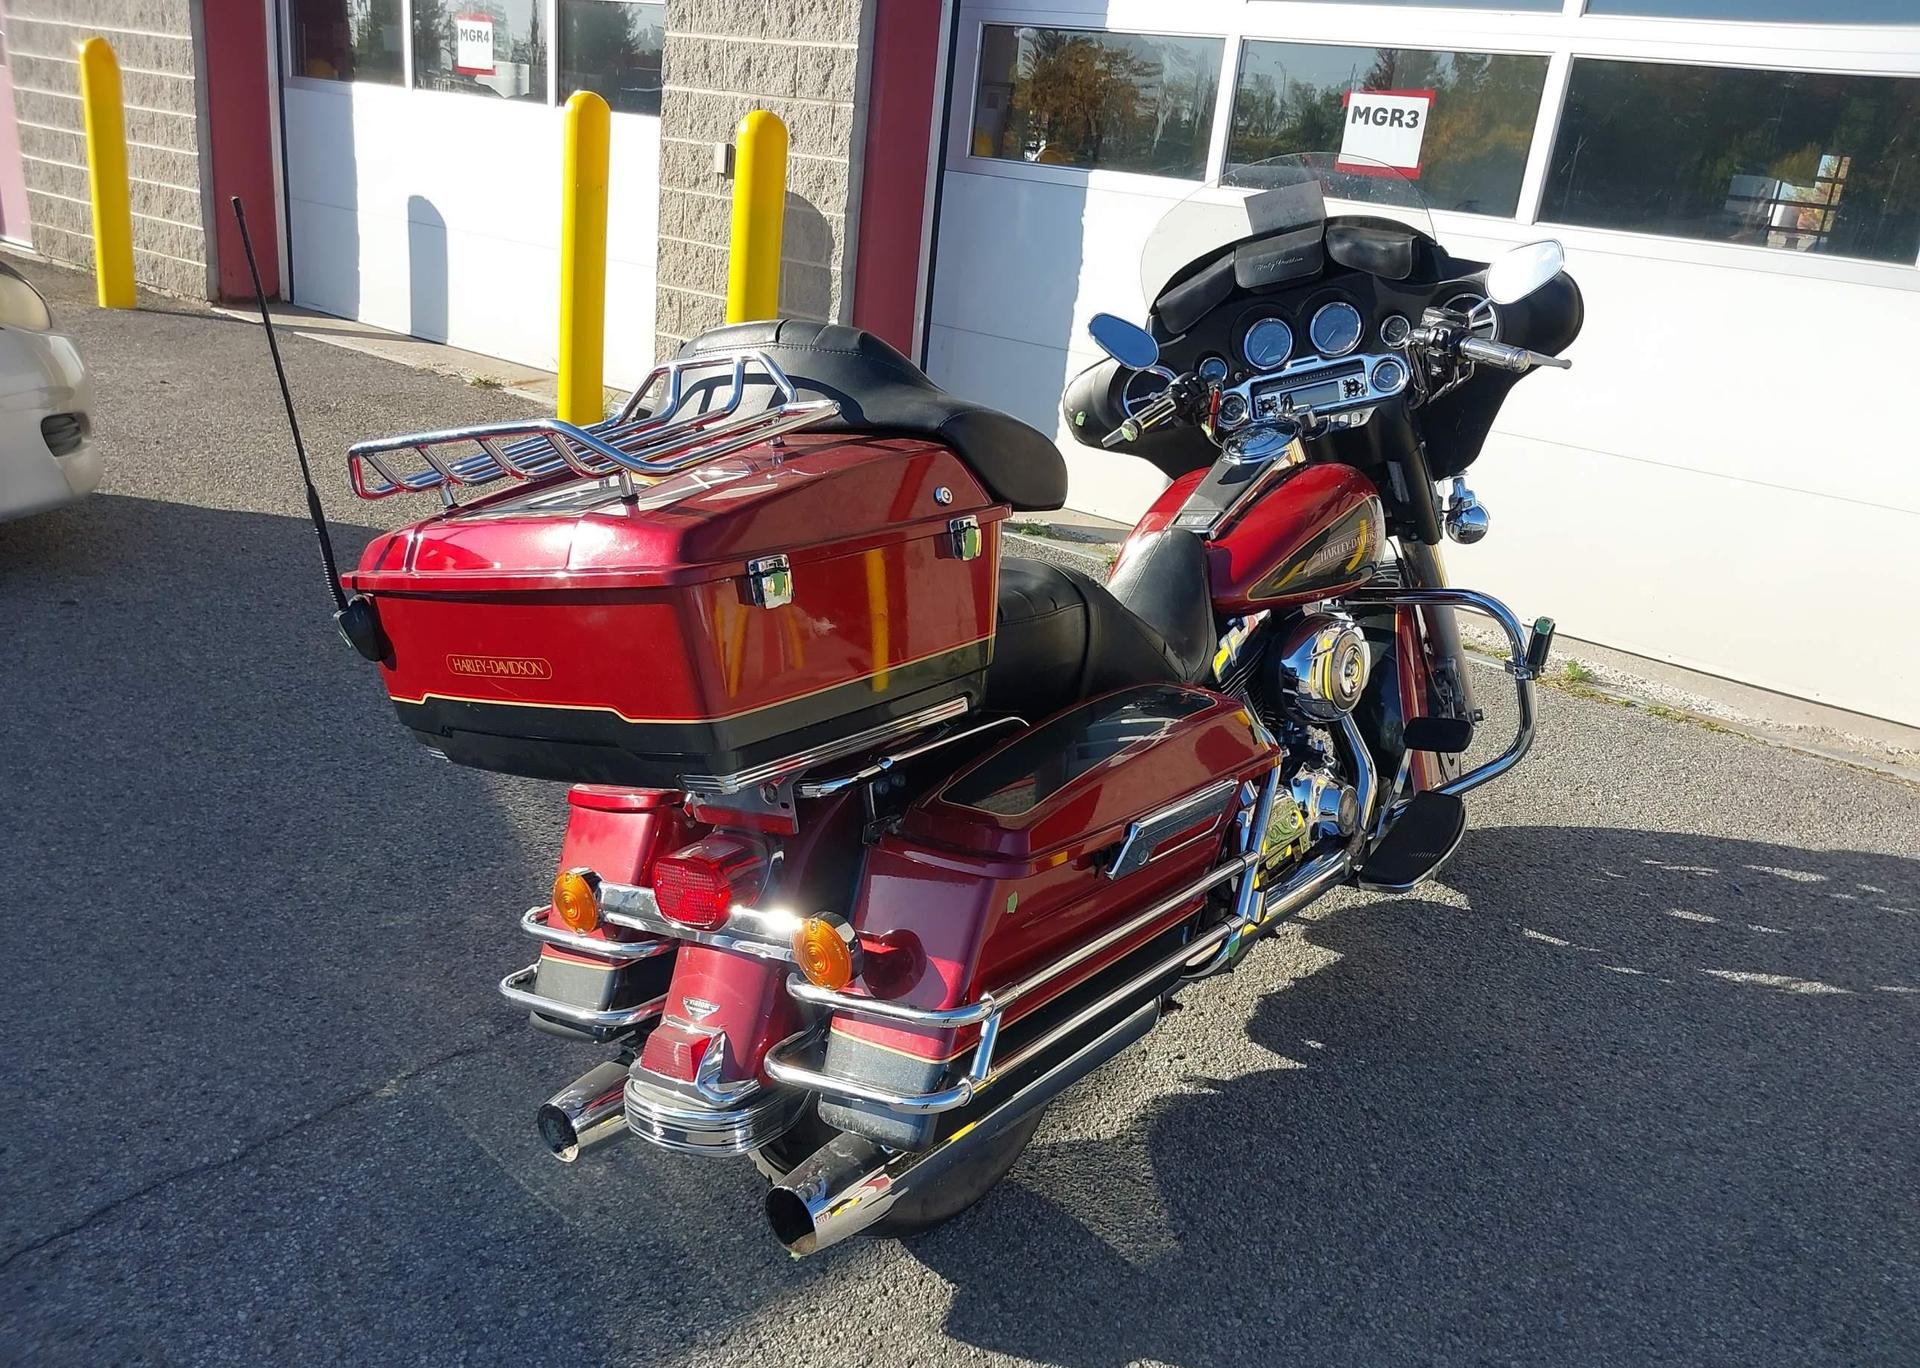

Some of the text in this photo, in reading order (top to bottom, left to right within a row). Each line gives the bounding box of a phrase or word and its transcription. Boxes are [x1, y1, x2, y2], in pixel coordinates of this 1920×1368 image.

[460, 28, 490, 43] MGR4
[1351, 105, 1420, 129] MGR3
[452, 658, 545, 676] HARLEY-DAVIDSON
